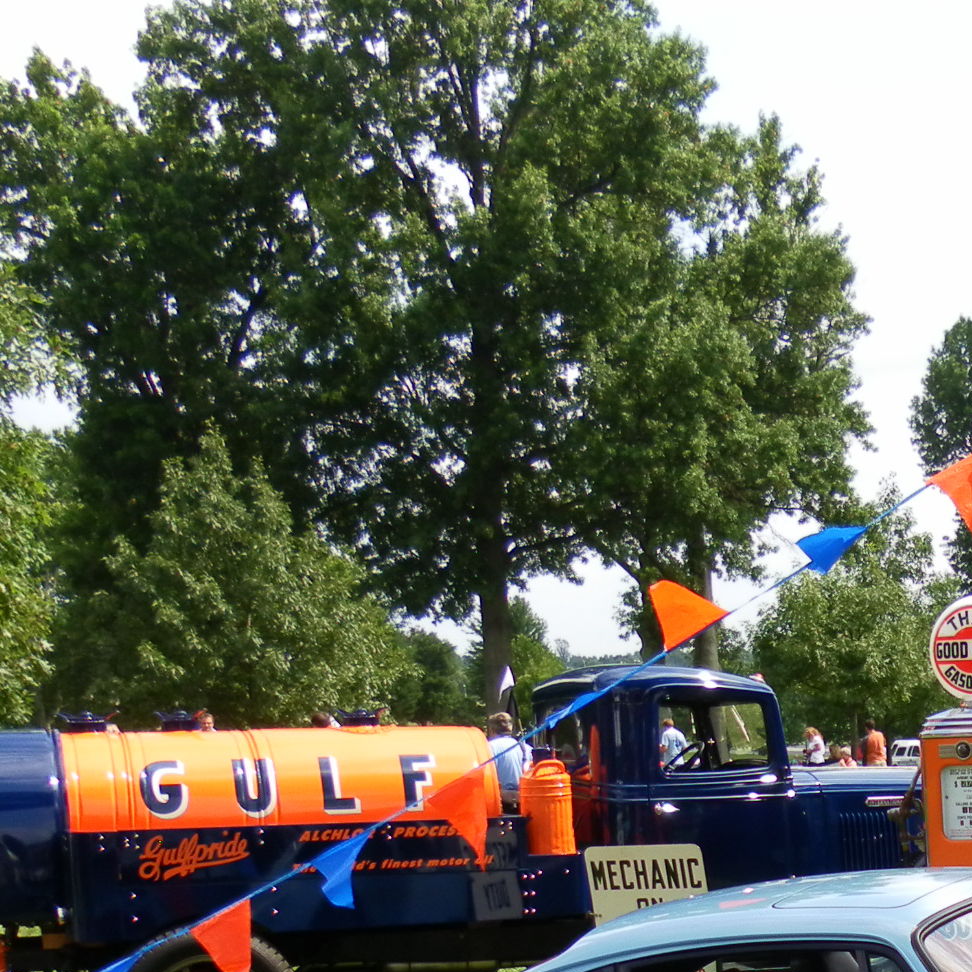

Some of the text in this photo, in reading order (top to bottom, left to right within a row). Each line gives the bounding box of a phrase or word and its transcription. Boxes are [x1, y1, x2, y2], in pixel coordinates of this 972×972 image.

[936, 640, 968, 660] GOOD
[139, 753, 436, 820] GULF
[393, 825, 463, 839] PROCES
[138, 831, 250, 881] Gulfpride
[381, 858, 423, 870] finest
[426, 857, 471, 868] motor
[589, 857, 703, 891] MECHANIC
